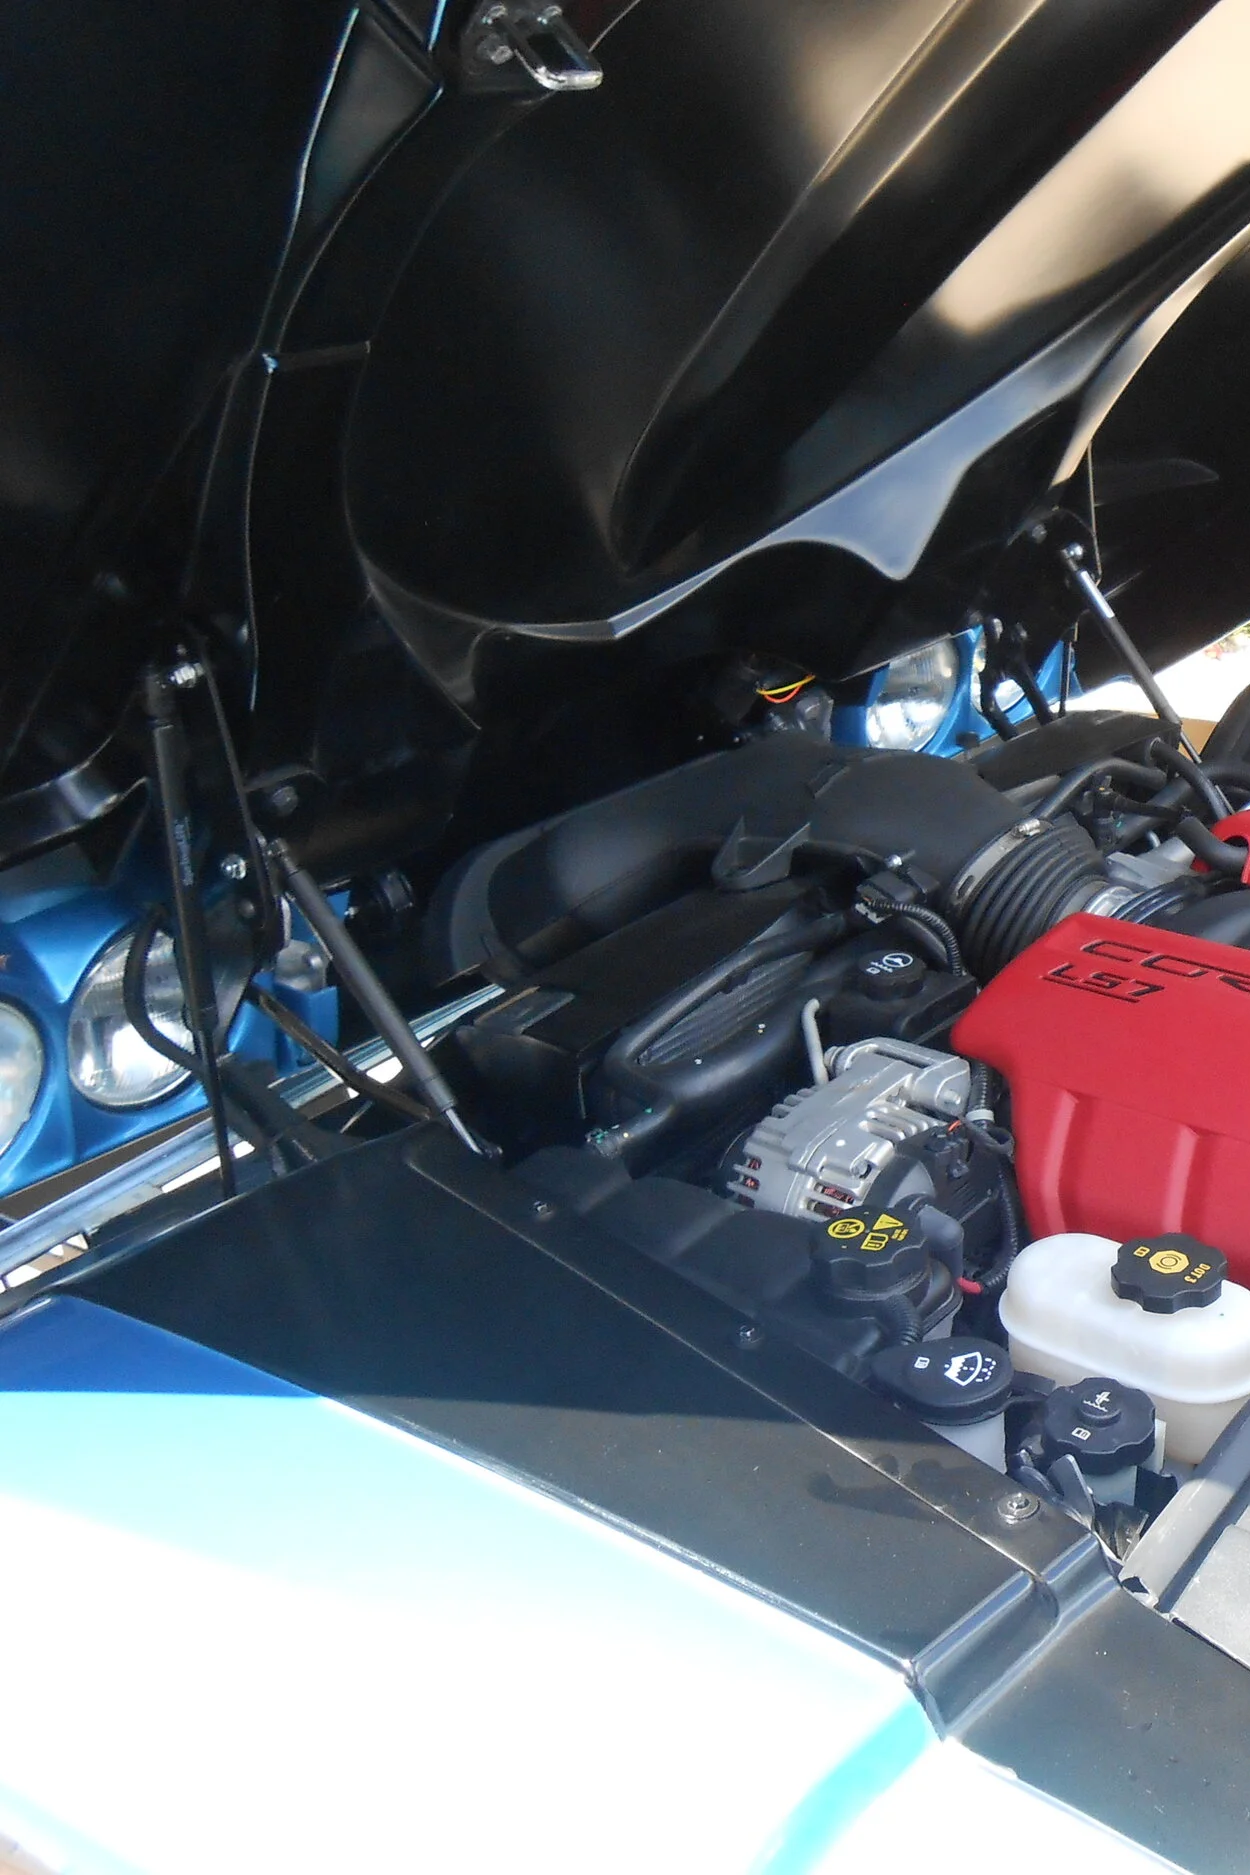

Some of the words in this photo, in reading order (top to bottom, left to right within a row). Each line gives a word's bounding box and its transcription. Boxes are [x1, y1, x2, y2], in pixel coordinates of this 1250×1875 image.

[1042, 962, 1166, 1002] LS7
[1190, 1263, 1211, 1279] DOT
[1184, 1275, 1197, 1284] 3
